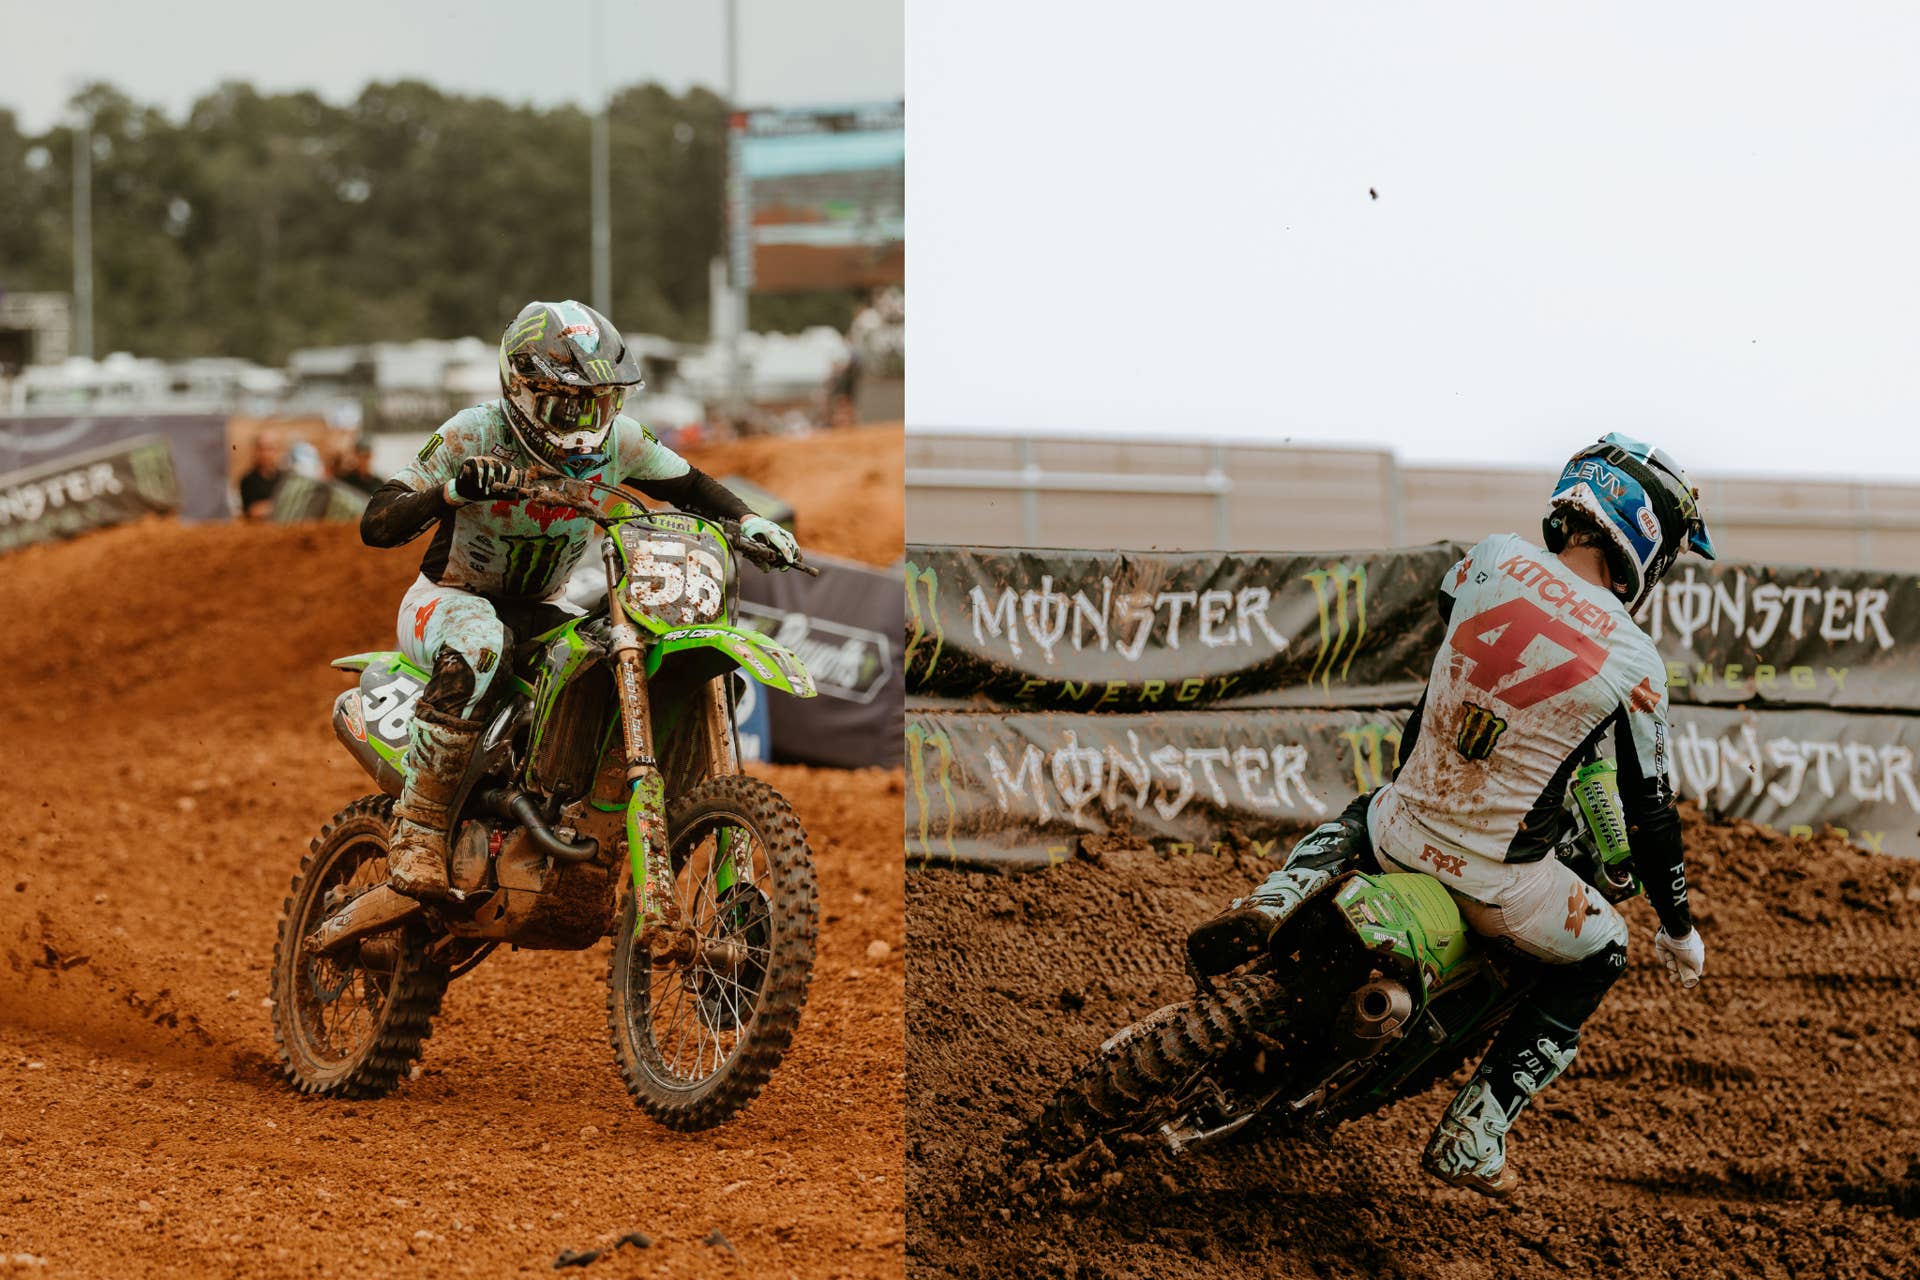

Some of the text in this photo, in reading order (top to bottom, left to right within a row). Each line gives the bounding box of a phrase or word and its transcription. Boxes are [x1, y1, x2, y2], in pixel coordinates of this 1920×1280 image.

[1640, 511, 1657, 538] BELL
[628, 539, 724, 615] 56
[1498, 555, 1617, 638] KITCHEN
[969, 574, 1290, 664] MONSTER
[1450, 597, 1610, 711] 47
[1666, 660, 1849, 691] ENERGY
[1014, 677, 1241, 702] ENERGY
[1654, 720, 1664, 751] PRO
[1667, 721, 1920, 815] ONSTER
[984, 729, 1329, 829] MONSTER
[1583, 785, 1617, 853] RENTHAL
[1592, 780, 1627, 847] RENTHAL
[1419, 843, 1468, 878] FOX
[1670, 862, 1688, 907] FOX
[1517, 1048, 1545, 1075] FOX
